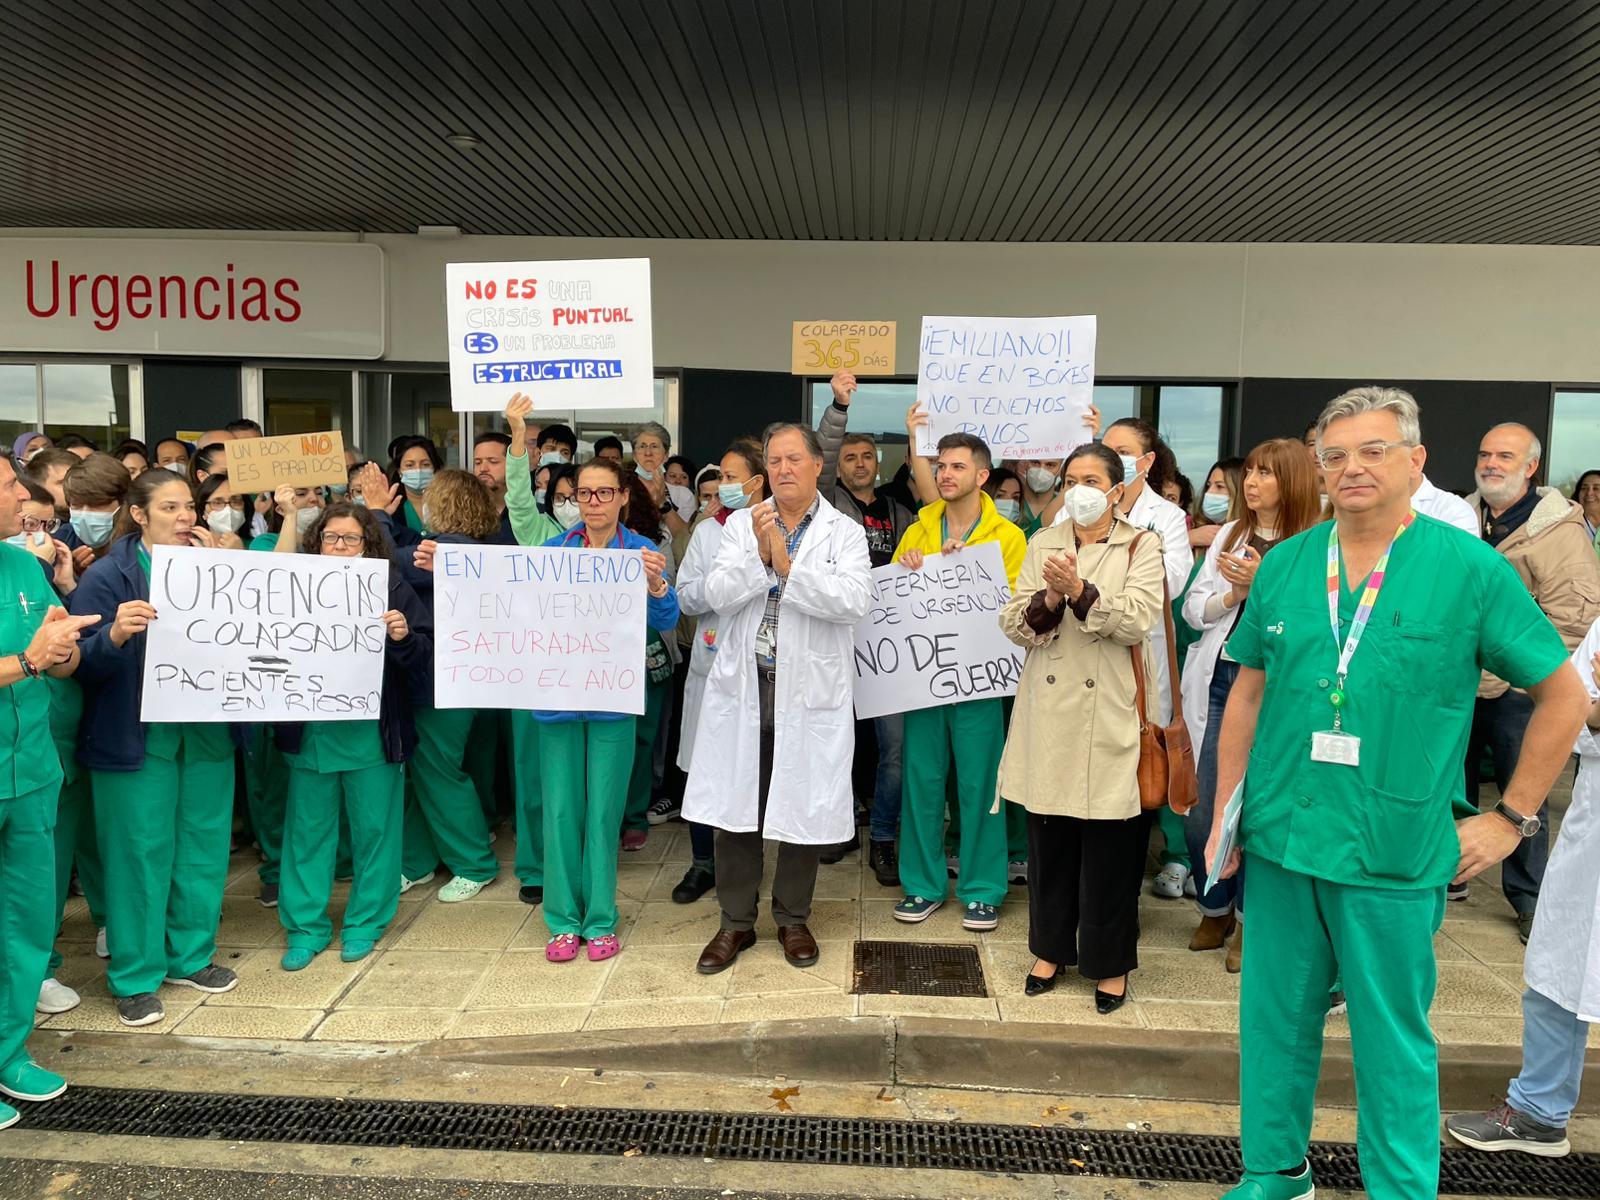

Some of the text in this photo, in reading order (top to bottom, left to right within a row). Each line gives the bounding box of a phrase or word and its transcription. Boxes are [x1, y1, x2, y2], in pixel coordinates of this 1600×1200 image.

[26, 260, 301, 331] Urgencias
[465, 279, 592, 301] NO ES UNA
[552, 307, 634, 326] PUNTUAL
[466, 333, 616, 353] ES UN PROBLEMA
[800, 324, 890, 337] COLAPSADO
[804, 338, 889, 369] 365 DÍAS
[474, 361, 623, 383] ESTRUCTURAL
[925, 362, 1090, 388] QUE EN BOXES
[928, 394, 1067, 415] NO TENEMOS
[232, 434, 333, 460] UN BOX NO
[237, 455, 344, 482] ES PARA DOS
[445, 551, 642, 584] EN INVIERNO
[870, 560, 993, 602] NFERMERIA
[445, 590, 633, 620] Y EN VERANO
[869, 606, 902, 625] DE
[186, 619, 384, 654] COLAPSADAS
[451, 628, 611, 656] SATURADAS
[854, 633, 959, 678] NO DE
[444, 664, 524, 684] TODO
[537, 668, 571, 688] EL
[585, 661, 636, 691] AÑO
[222, 696, 266, 712] EN
